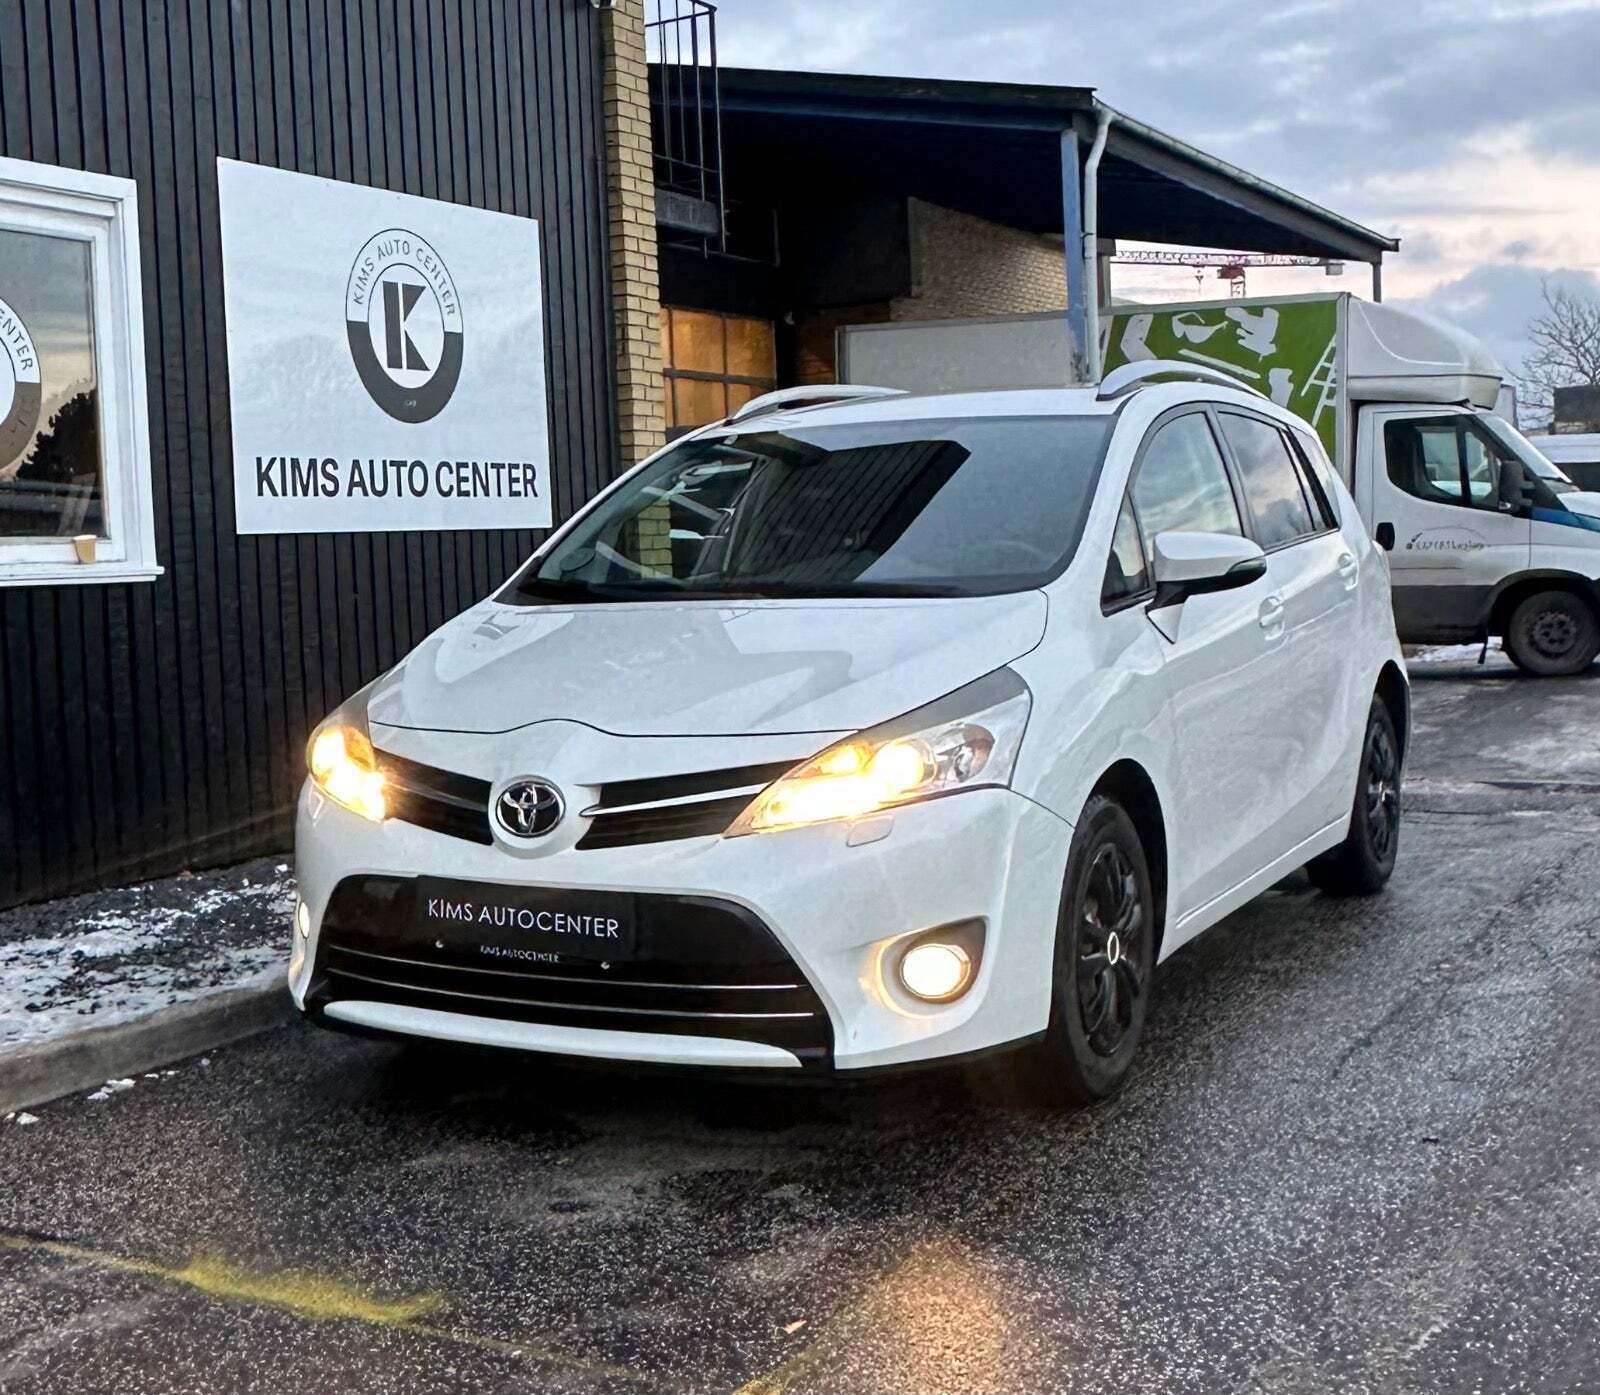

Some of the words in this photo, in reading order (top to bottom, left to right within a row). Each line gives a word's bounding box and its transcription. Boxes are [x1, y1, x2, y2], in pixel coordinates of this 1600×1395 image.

[353, 257, 375, 305] KIMS
[377, 240, 411, 261] AUTO
[415, 248, 455, 316] CENTER
[382, 280, 431, 371] K
[255, 456, 340, 497] KIMS
[346, 459, 429, 498] AUTO
[435, 461, 539, 498] CENTER
[428, 899, 473, 922] KIMS
[478, 906, 619, 938] AUTOCENTER
